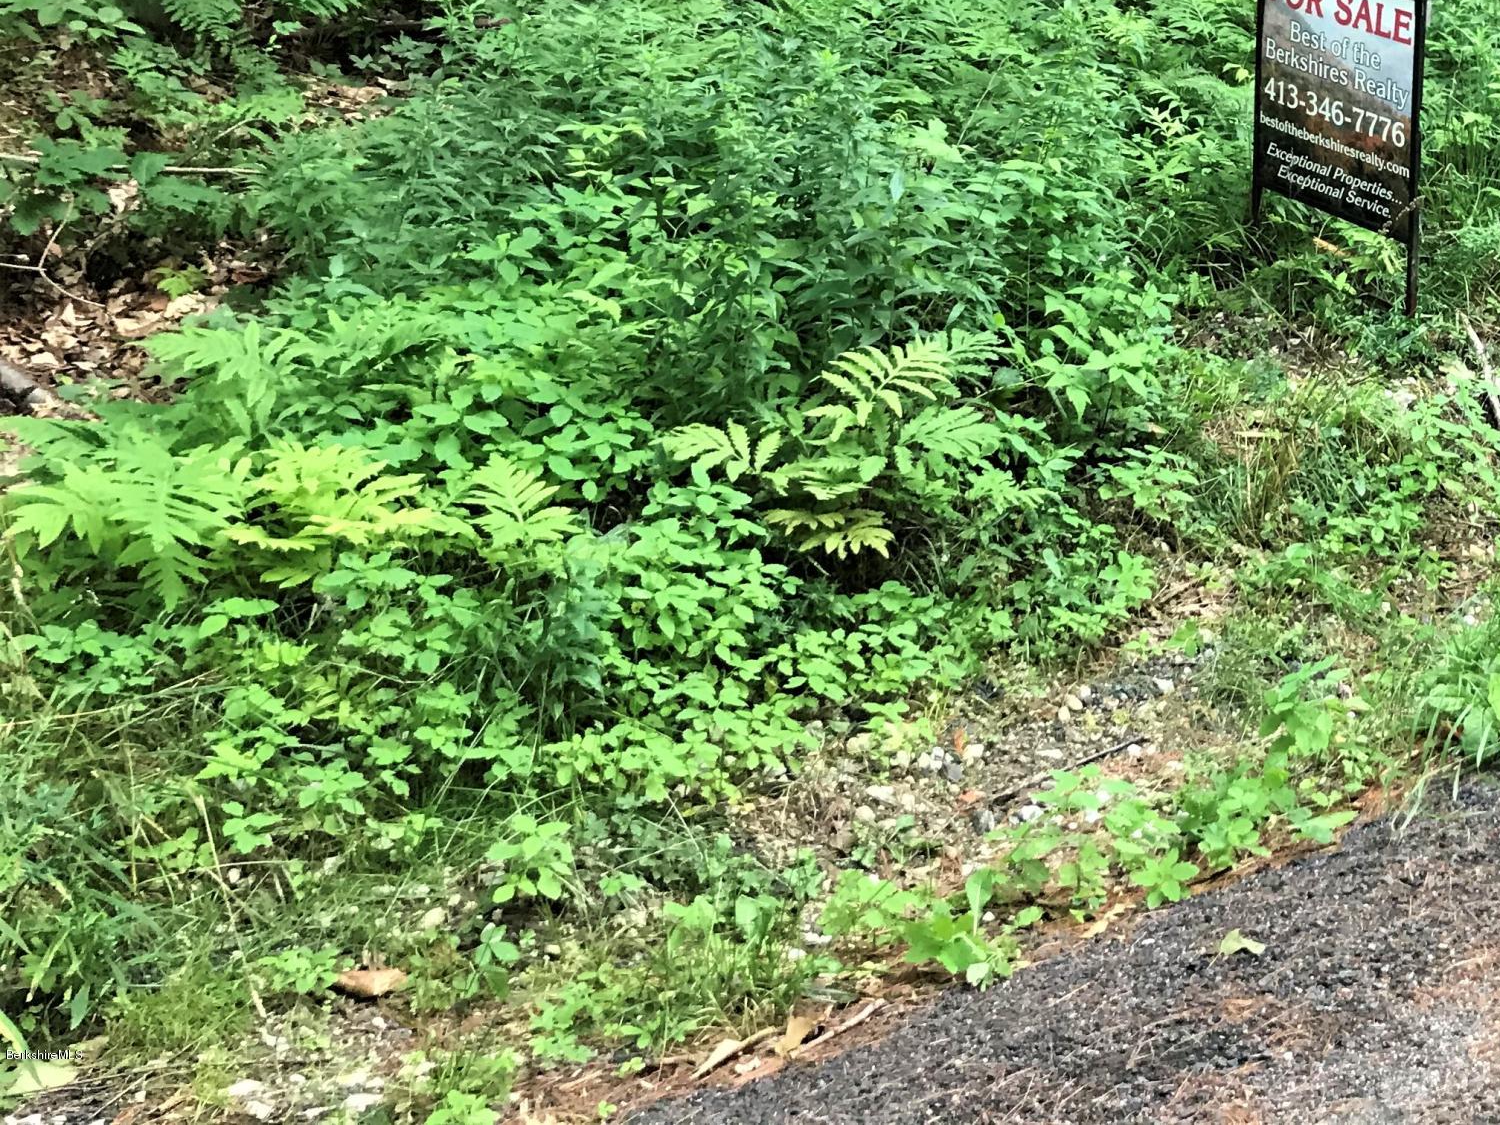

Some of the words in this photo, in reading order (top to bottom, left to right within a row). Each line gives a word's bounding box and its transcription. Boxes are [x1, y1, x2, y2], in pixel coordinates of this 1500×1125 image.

[1265, 37, 1348, 86] Berkshires
[1354, 68, 1409, 110] Realty
[1290, 20, 1327, 52] Best
[1331, 36, 1350, 59] of
[1353, 41, 1382, 70] the
[1260, 110, 1410, 179] bestoftheberkshiresrealty.com
[1264, 77, 1406, 148] 413-346-7776
[1266, 141, 1332, 177] Exceptional
[1332, 168, 1402, 205] Properties...
[1277, 164, 1344, 199] Exceptional
[1346, 189, 1391, 218] Service.
